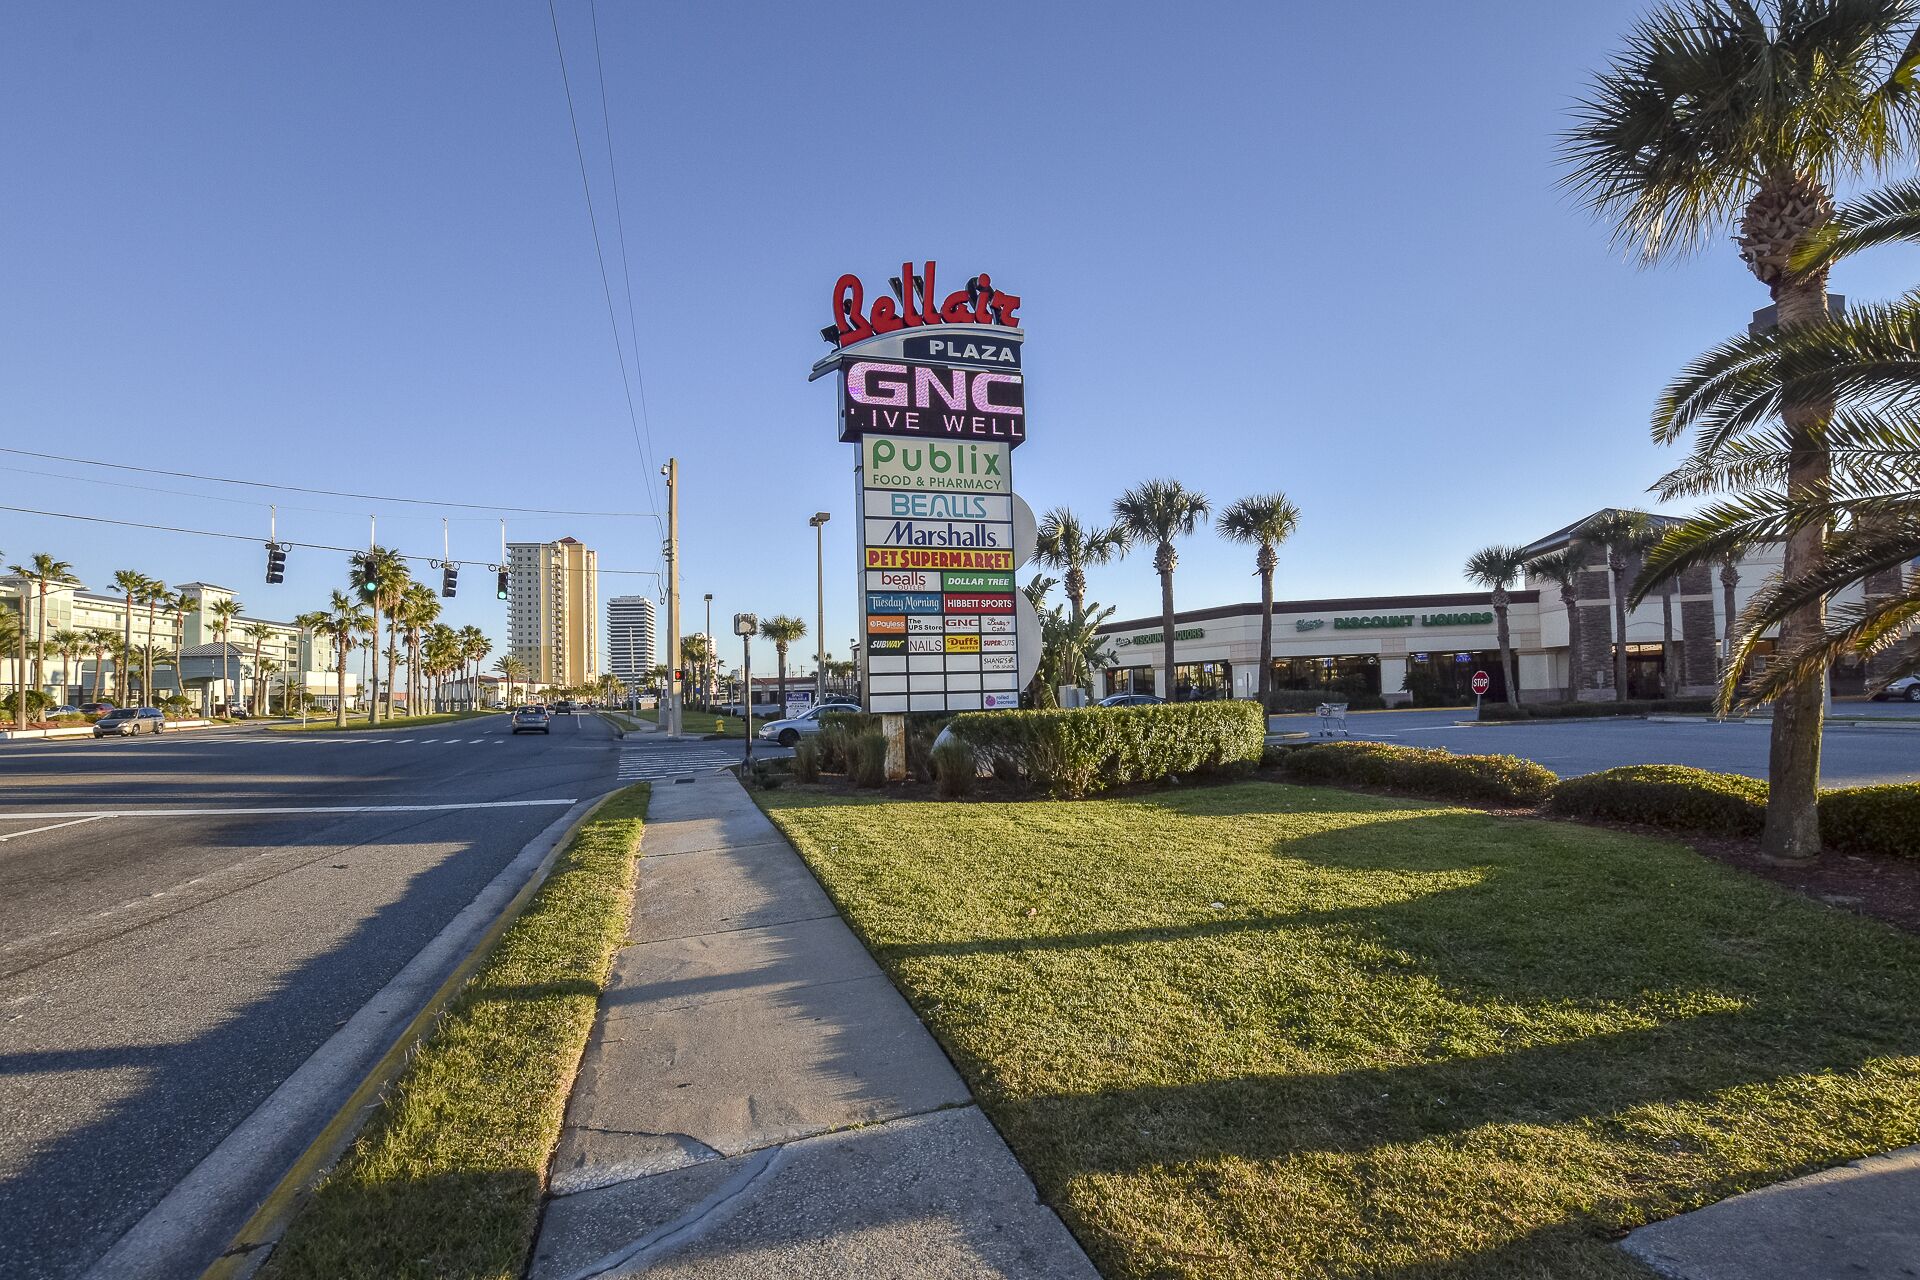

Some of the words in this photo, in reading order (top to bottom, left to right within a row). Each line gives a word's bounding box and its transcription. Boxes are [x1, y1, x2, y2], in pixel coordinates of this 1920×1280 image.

[833, 261, 1020, 347] Bellair
[930, 340, 1015, 362] PLAZA
[848, 362, 1023, 415] GNC
[851, 408, 920, 430] IVE
[943, 415, 1023, 436] WELL
[873, 439, 1000, 475] Publix
[873, 474, 911, 486] FOOD
[916, 476, 925, 486] &
[930, 477, 1001, 490] PHARMACY
[891, 493, 987, 518] BEALLS
[868, 550, 898, 566] PET
[900, 551, 1010, 569] SUPERMARKET
[882, 572, 926, 585] bealls
[948, 577, 984, 585] DOLLAR
[987, 578, 1009, 586] TREE
[869, 596, 904, 610] Tuesday
[904, 596, 939, 611] Morning
[947, 600, 979, 608] HIBBETT
[980, 600, 1012, 608] SPORTS
[876, 620, 905, 629] Payless
[1334, 615, 1415, 629] DISCOUNT
[1422, 612, 1493, 626] LIQUORS
[870, 640, 905, 648] SUBWAY
[910, 640, 942, 651] NAILS
[947, 637, 978, 646] Duff's
[1473, 678, 1488, 687] STOP
